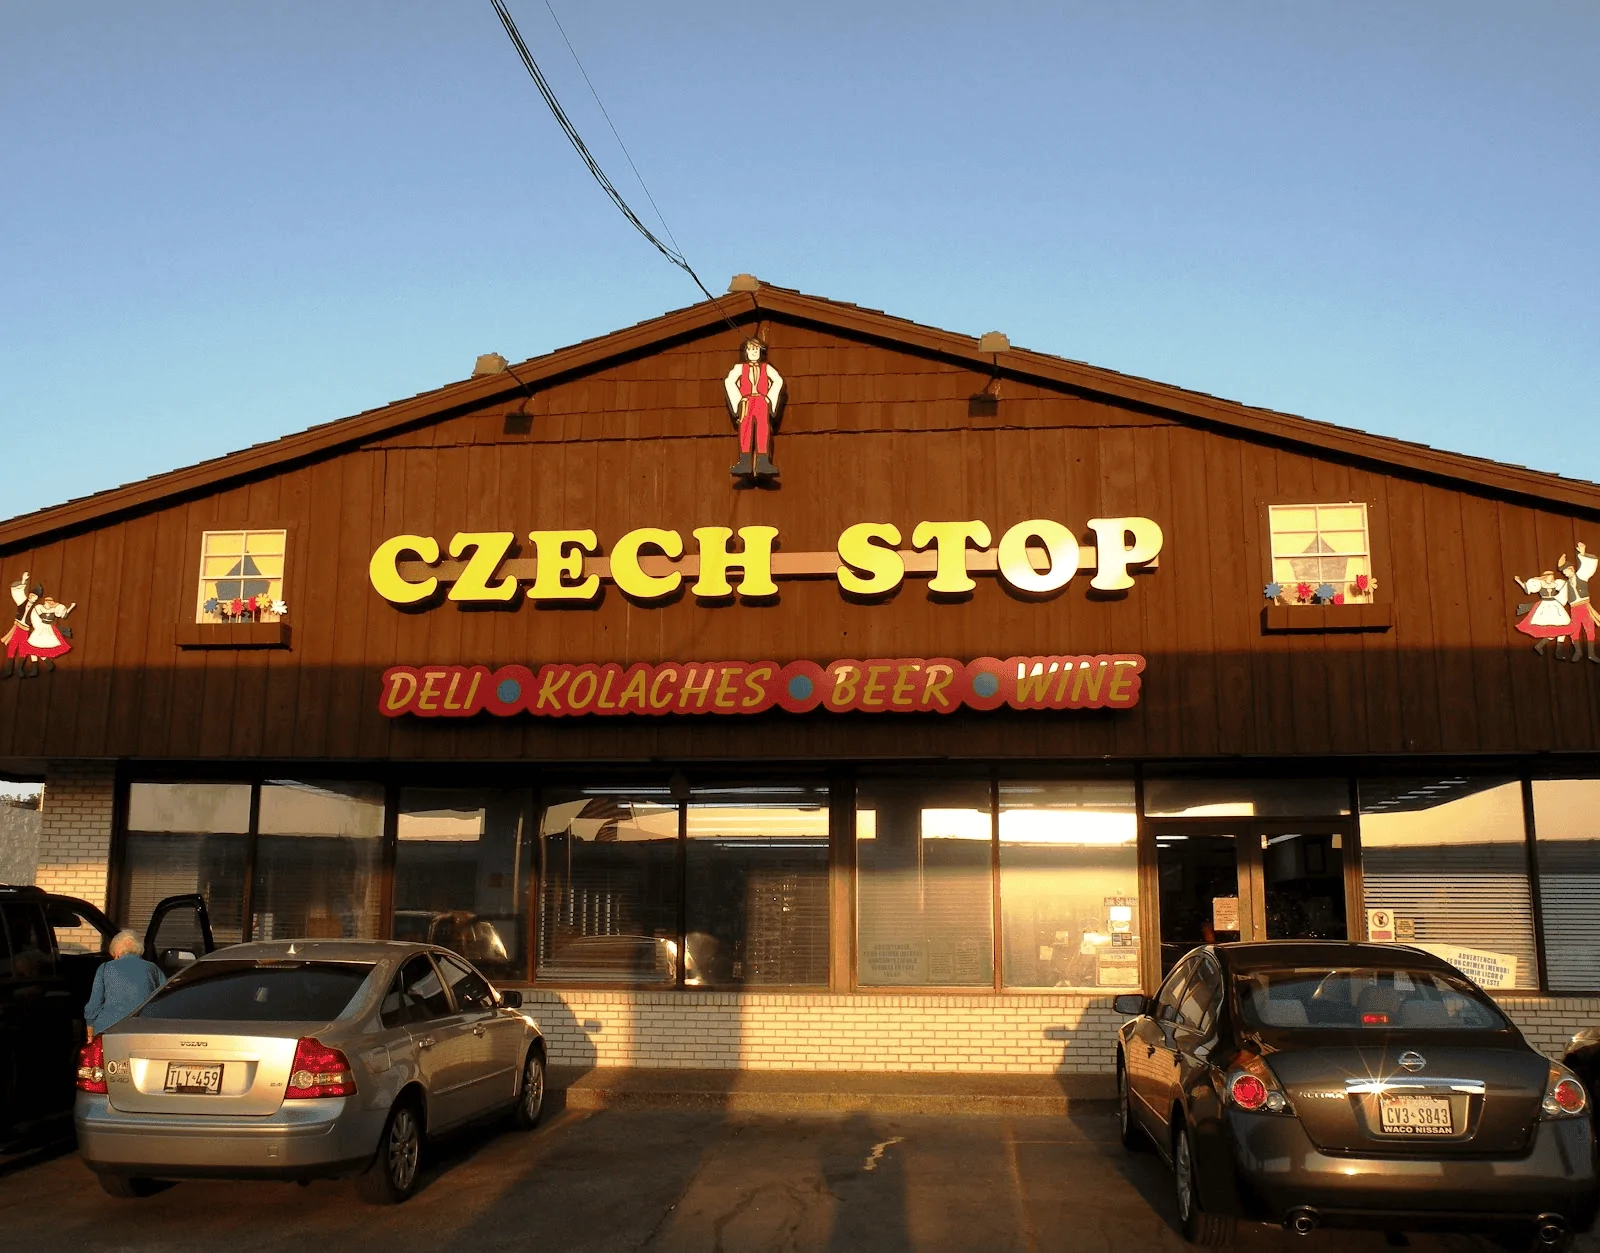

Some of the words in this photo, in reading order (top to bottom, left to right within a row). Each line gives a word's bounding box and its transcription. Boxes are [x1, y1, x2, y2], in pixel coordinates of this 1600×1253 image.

[369, 526, 779, 603] CZECH
[837, 517, 1163, 594] STOP
[386, 671, 482, 711] DELI
[536, 667, 772, 710] KOLACHES
[832, 665, 954, 707] BEER
[1016, 660, 1138, 702] WINE
[1415, 1126, 1453, 1134] NISSAN
